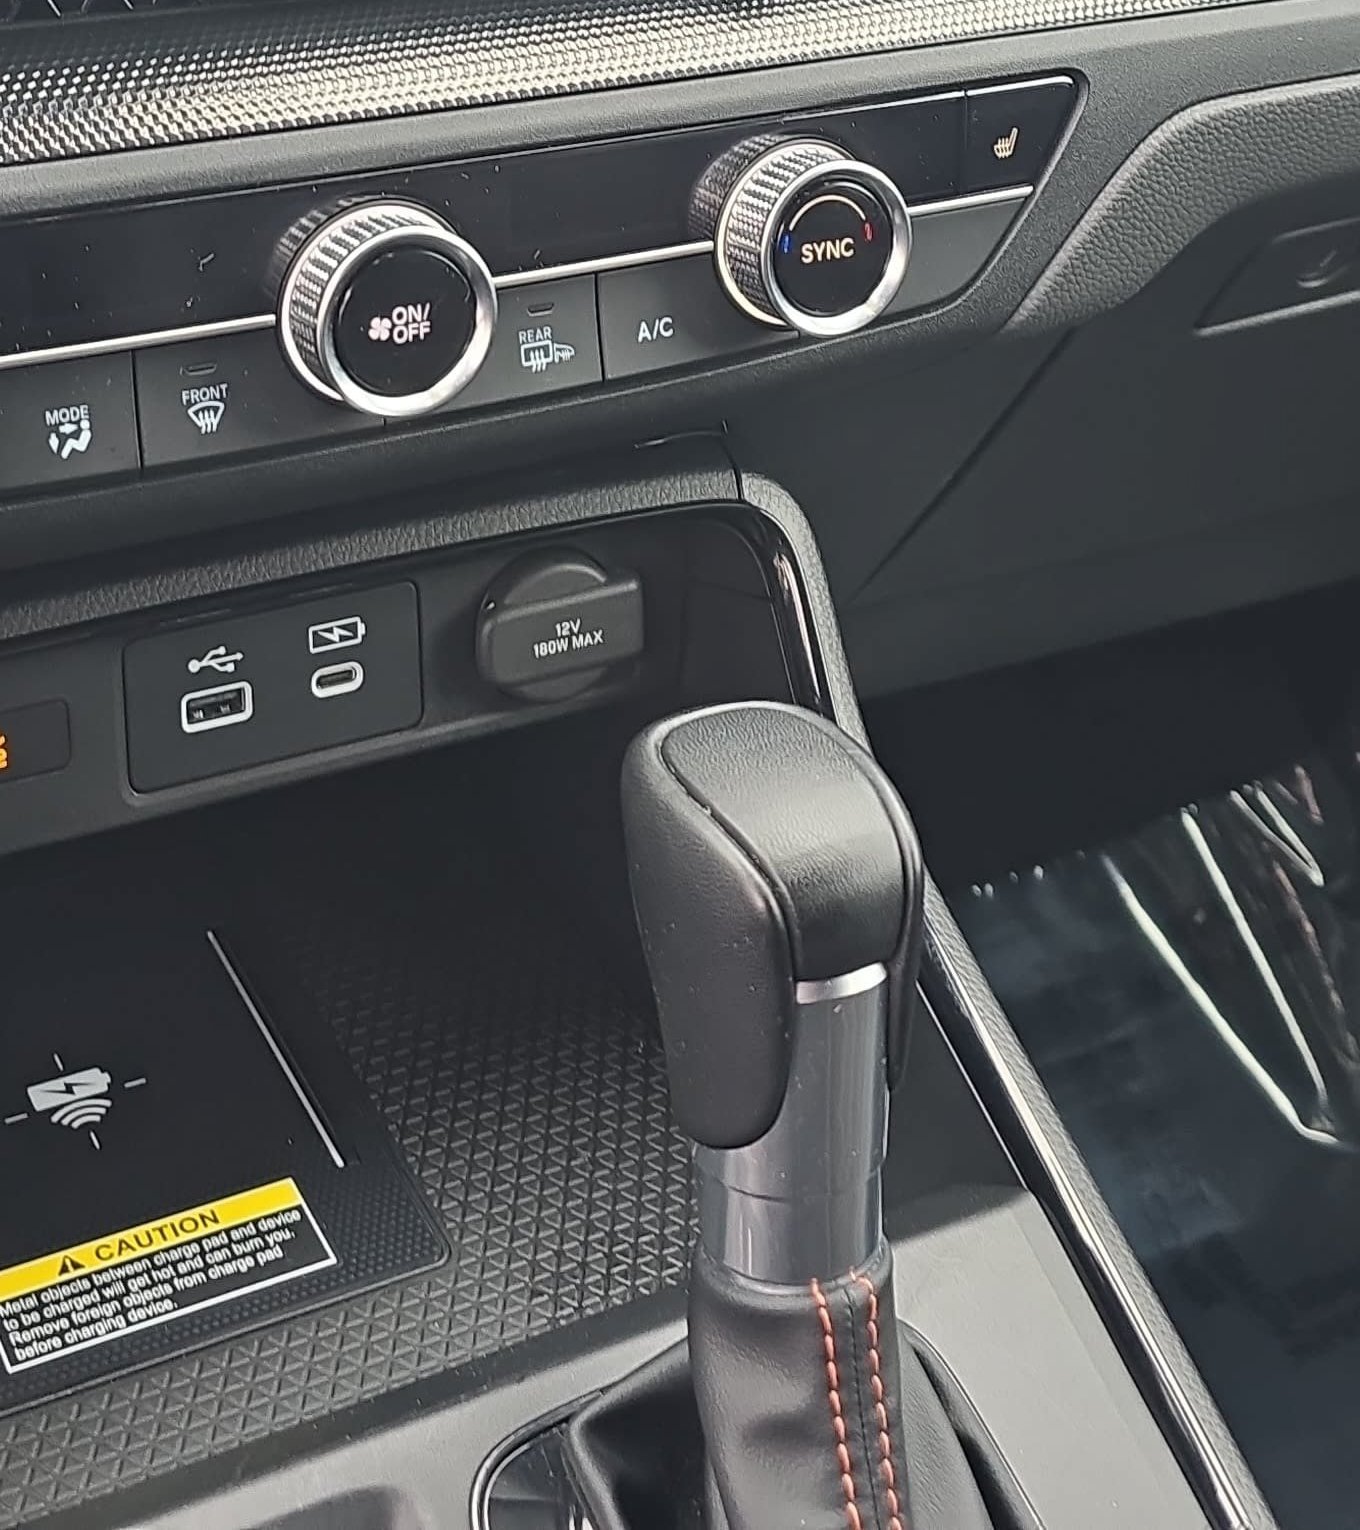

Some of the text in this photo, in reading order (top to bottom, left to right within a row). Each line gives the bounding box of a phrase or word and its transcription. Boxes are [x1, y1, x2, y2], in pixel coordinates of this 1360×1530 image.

[800, 236, 855, 265] SYNC
[392, 303, 431, 324] ON/
[392, 321, 431, 344] OFF
[518, 326, 552, 343] REAR
[637, 316, 674, 343] A/C
[182, 383, 229, 406] FRONT
[45, 404, 91, 427] MODE
[555, 618, 581, 637] 12V
[533, 629, 603, 659] 180W MAX
[95, 1209, 220, 1261] CAUTION
[40, 1277, 91, 1301] objects
[91, 1258, 152, 1286] between
[153, 1242, 201, 1267] charge
[201, 1231, 229, 1250] pad
[230, 1222, 257, 1241] and
[258, 1209, 302, 1231] device
[2, 1318, 19, 1332] to
[20, 1310, 41, 1326] be
[43, 1291, 101, 1318] charged
[102, 1280, 126, 1300] will
[127, 1273, 151, 1292] get
[151, 1265, 176, 1283] hot
[176, 1255, 204, 1273] and
[205, 1247, 232, 1265] can
[231, 1236, 265, 1256] burn
[8, 1245, 284, 1347] Remove foreign objects from charge pad
[14, 1297, 178, 1362] before charging device.
